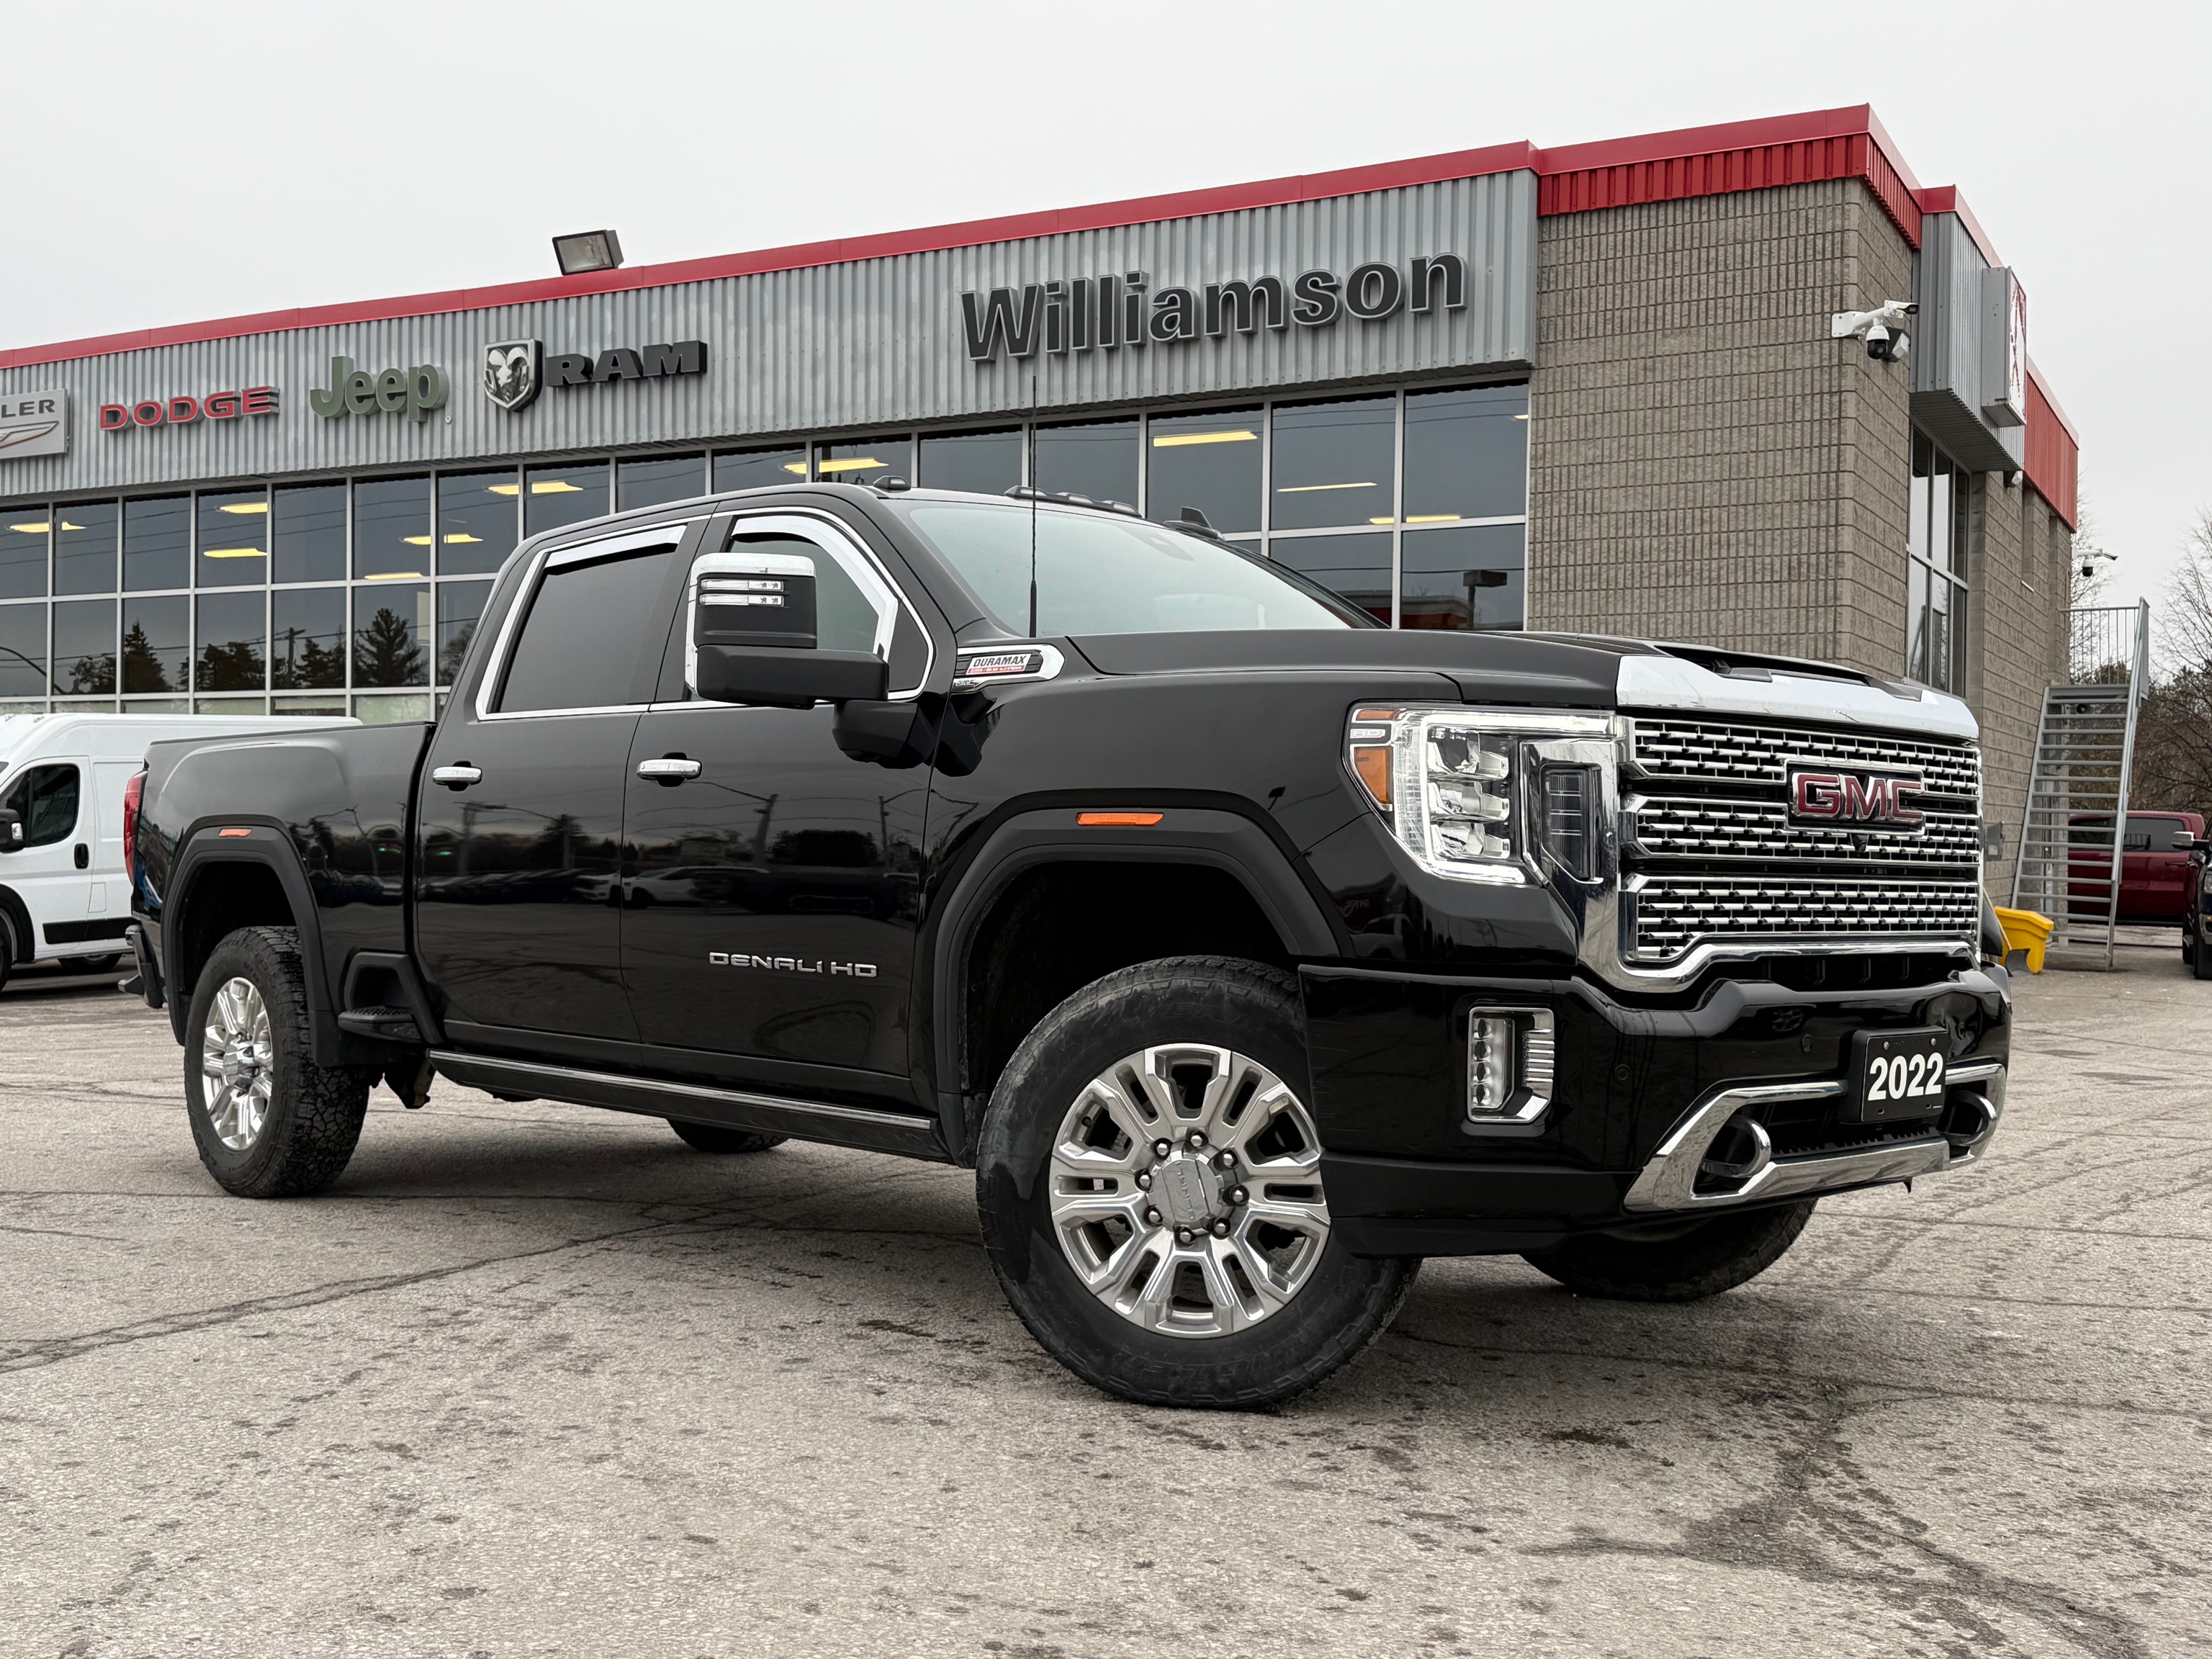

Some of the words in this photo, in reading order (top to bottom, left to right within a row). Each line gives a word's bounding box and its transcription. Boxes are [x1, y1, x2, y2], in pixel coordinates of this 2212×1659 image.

[959, 251, 1467, 361] Williamson
[545, 340, 707, 387] RAM
[99, 386, 279, 431] DODGE
[310, 356, 449, 423] Jeep
[973, 655, 1028, 667] DURAMAX
[1791, 772, 1923, 824] GMC
[709, 951, 823, 974] DENALI
[830, 961, 877, 978] HD
[1867, 1052, 1943, 1101] 2022
